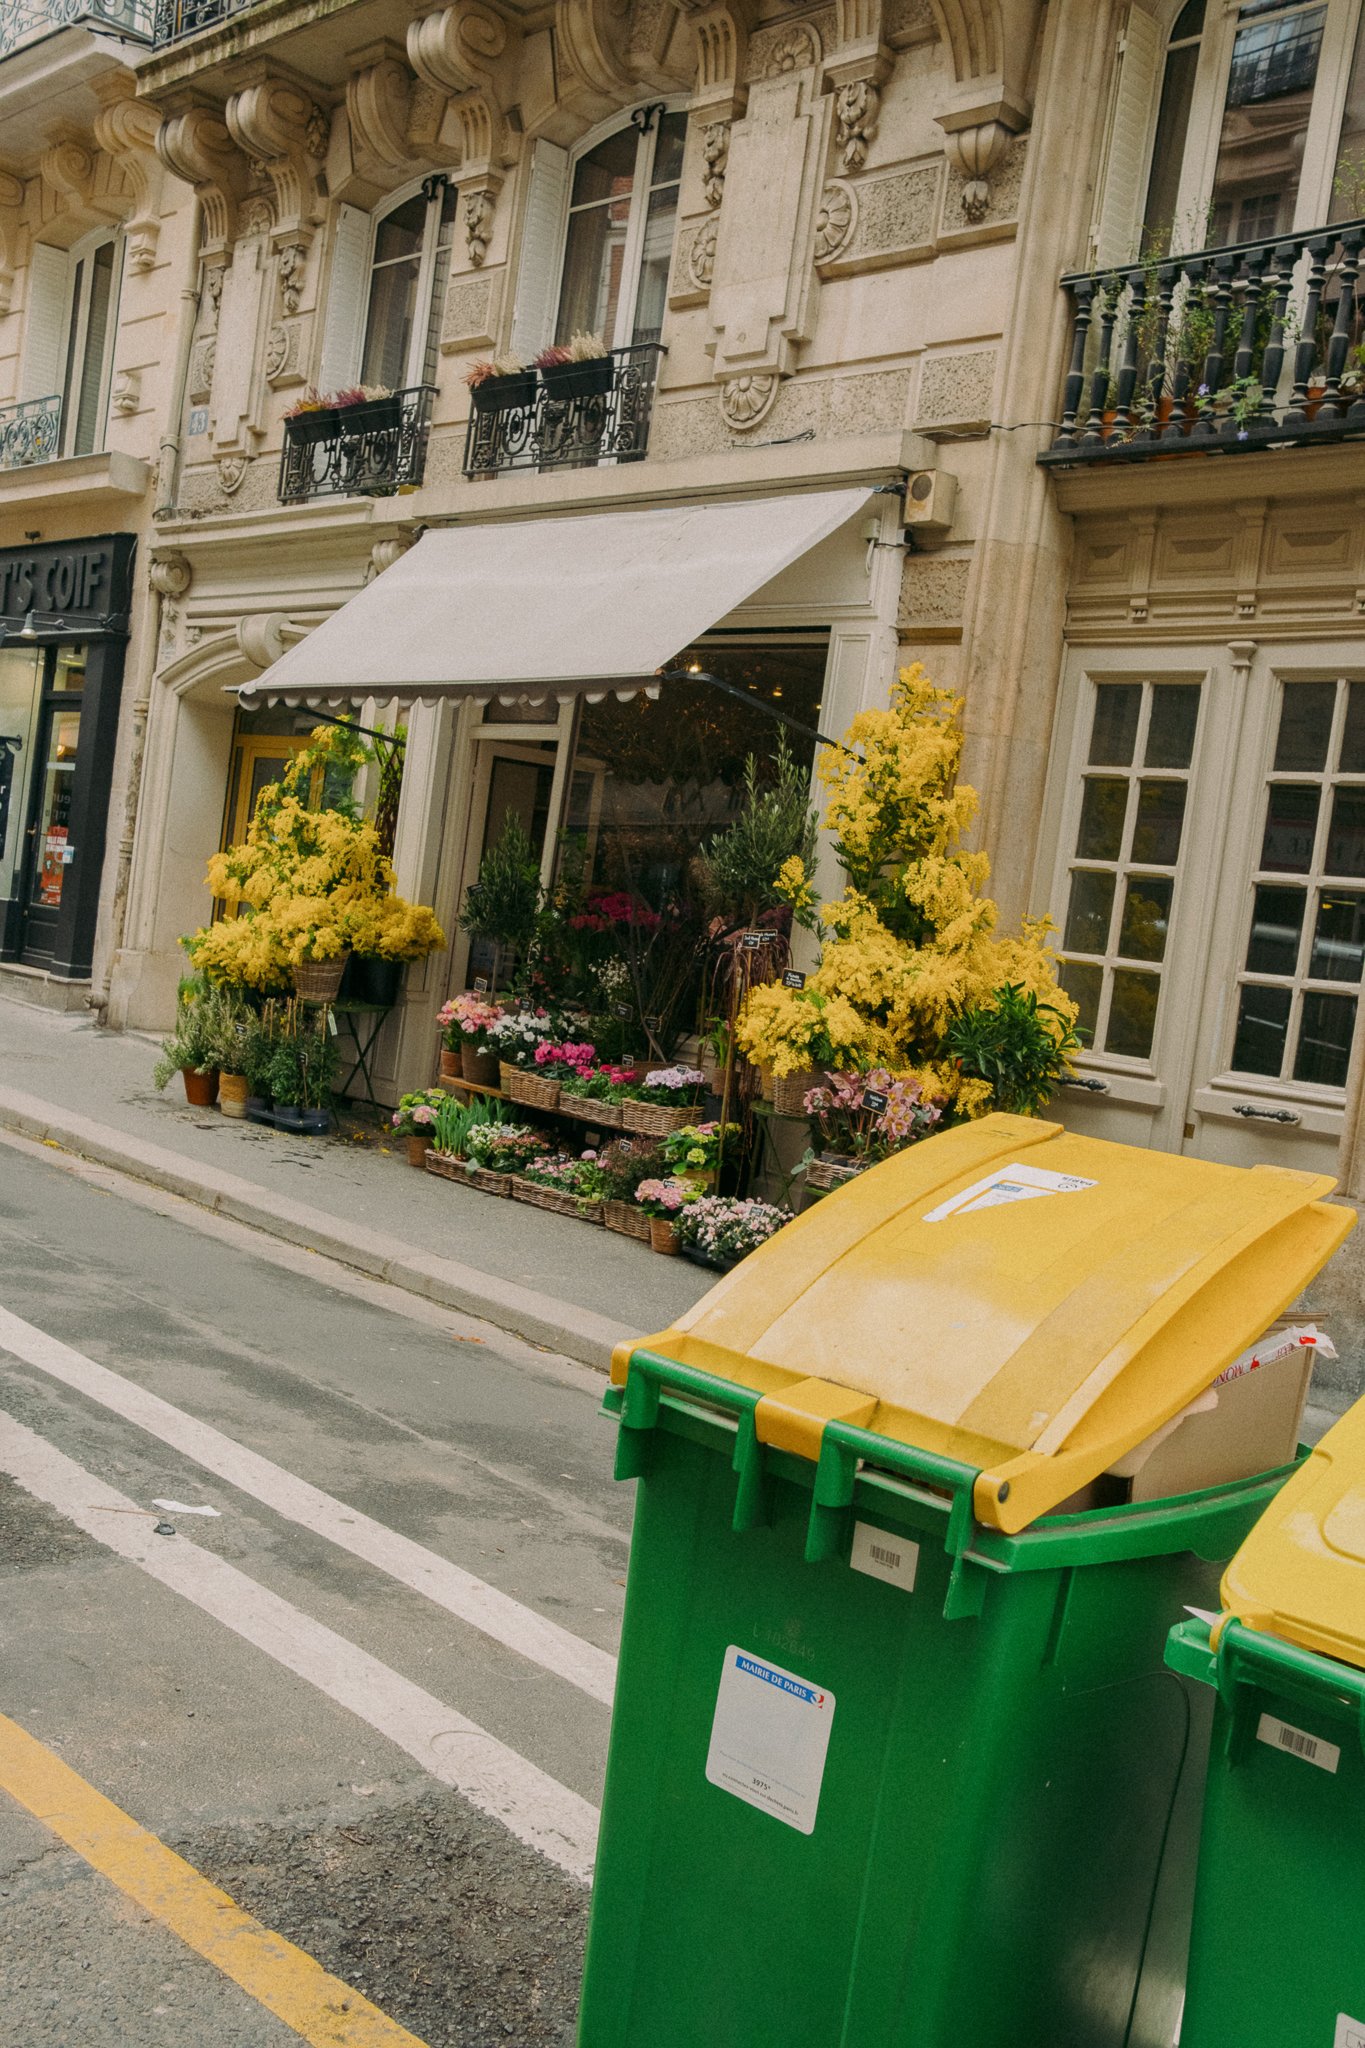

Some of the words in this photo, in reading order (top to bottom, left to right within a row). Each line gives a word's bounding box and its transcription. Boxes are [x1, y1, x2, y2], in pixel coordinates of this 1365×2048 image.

[43, 552, 103, 611] COIF
[740, 1659, 770, 1681] MAIRIE
[770, 1674, 783, 1686] DE
[783, 1681, 808, 1698] PARIS
